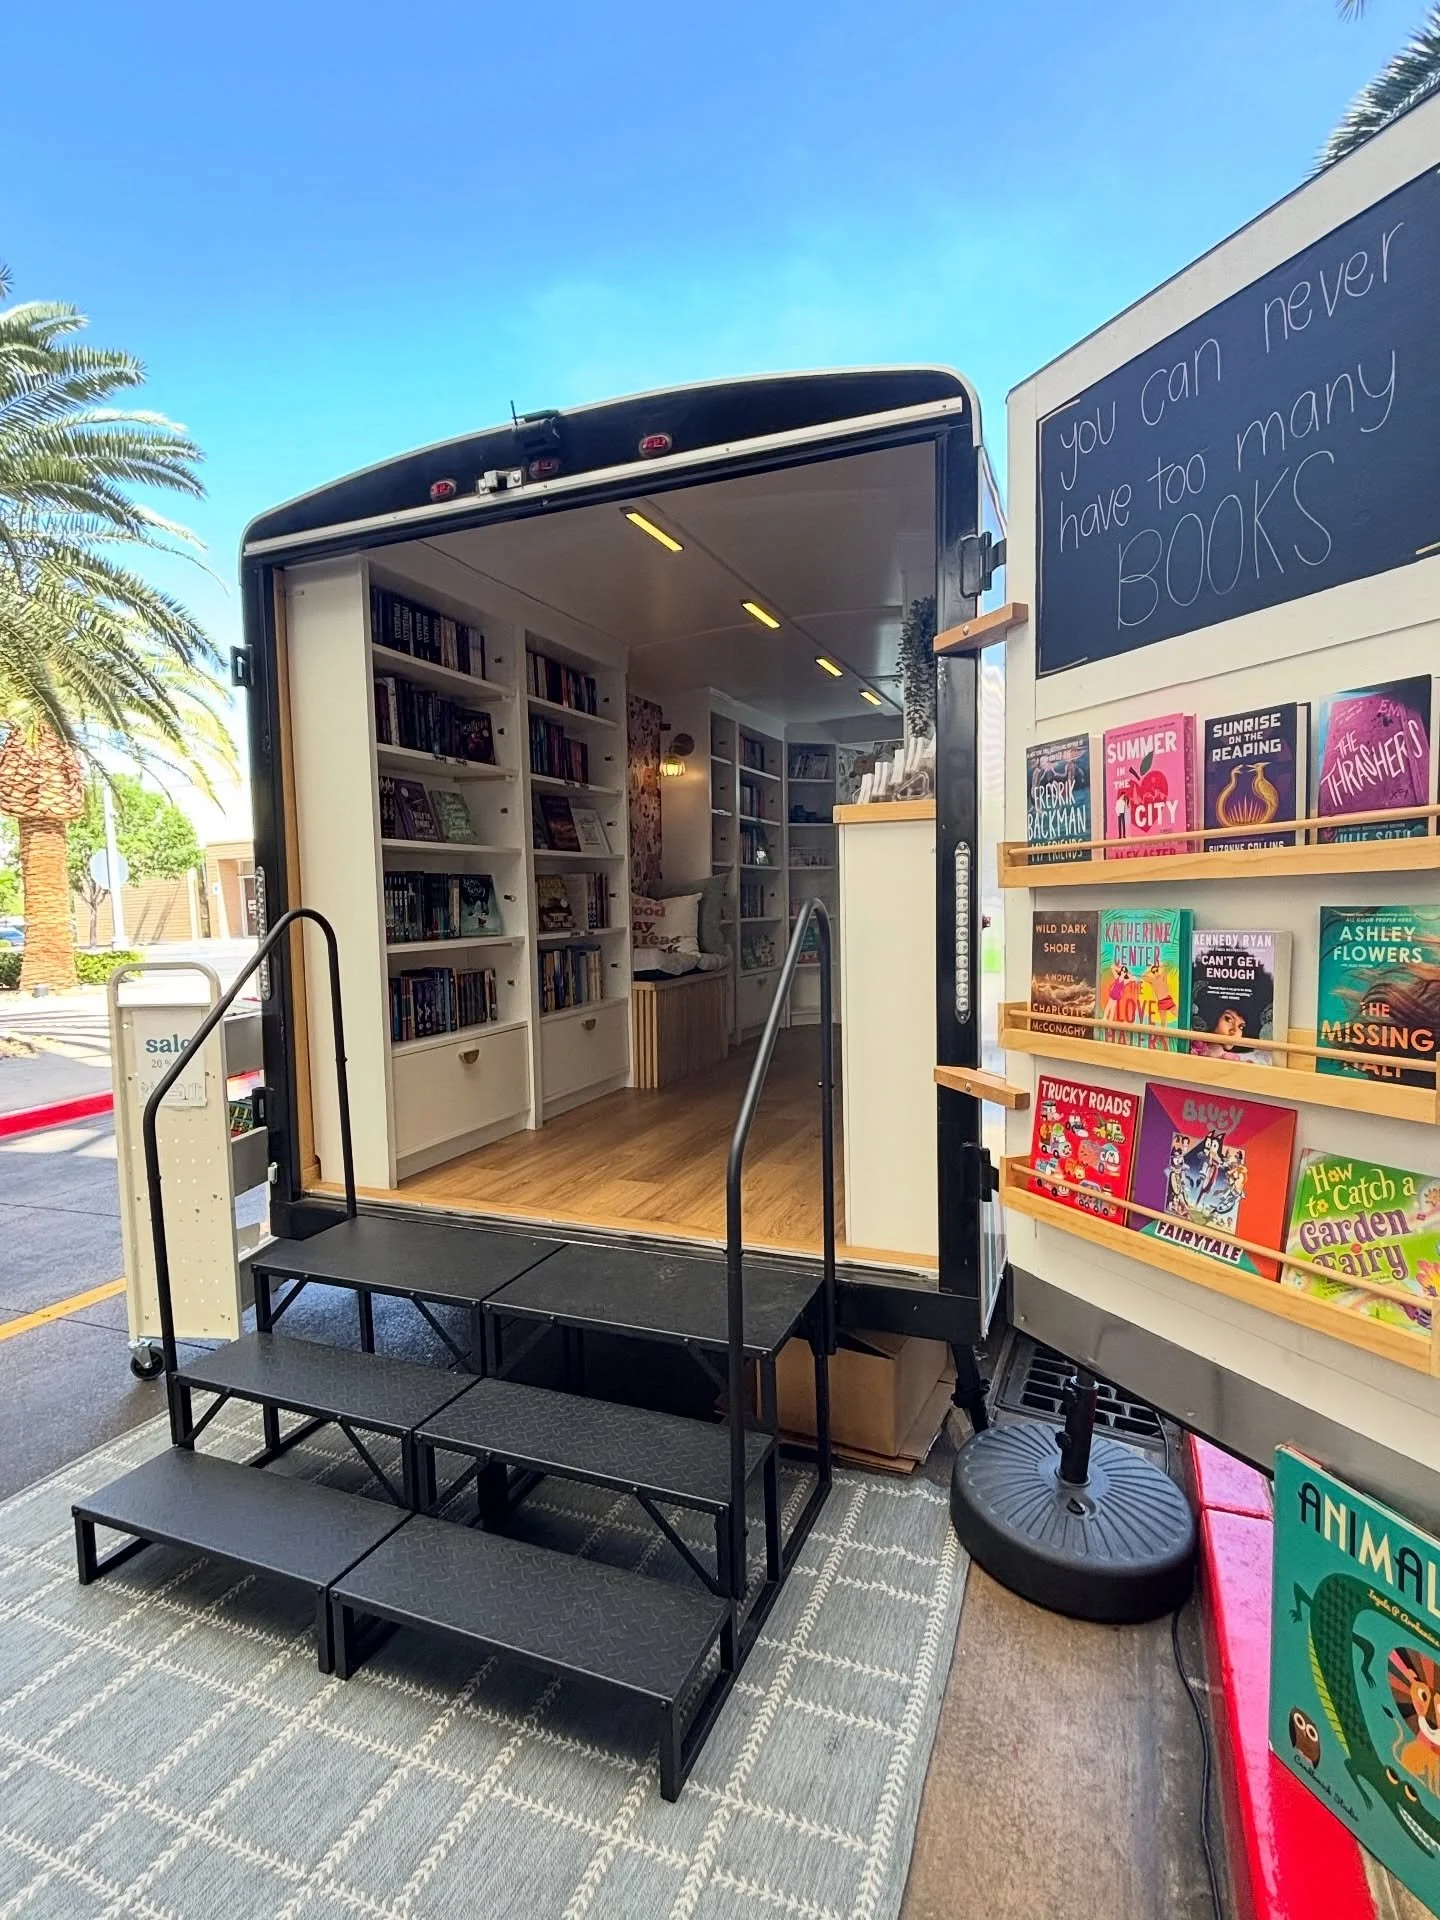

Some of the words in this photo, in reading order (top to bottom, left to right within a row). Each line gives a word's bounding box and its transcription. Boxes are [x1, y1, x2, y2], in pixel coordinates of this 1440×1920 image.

[1060, 401, 1116, 490] you
[1141, 338, 1221, 425] can
[1265, 221, 1404, 353] never
[1059, 483, 1132, 553] have
[1147, 452, 1207, 510] too
[1236, 350, 1396, 472] many
[1117, 450, 1335, 630] BOOKS
[1213, 713, 1281, 738] SUNRISE
[1107, 730, 1178, 764] SUMMER
[1229, 735, 1243, 745] ON
[1244, 731, 1264, 743] THE
[1335, 730, 1359, 759] THE
[1212, 738, 1282, 762] REAPING
[1116, 766, 1126, 777] IN
[1320, 719, 1423, 807] THRASHERS
[1113, 779, 1131, 790] THE
[1034, 779, 1076, 815] FREDRIK
[1027, 804, 1087, 841] BACKMAN
[1134, 799, 1179, 828] CITY
[632, 905, 666, 917] ood
[632, 921, 656, 933] ay
[1036, 924, 1057, 934] WILD
[1061, 924, 1087, 934] DARK
[1105, 922, 1172, 944] KATHERINE
[1340, 926, 1416, 942] ASHLEY
[1043, 942, 1076, 954] SHORE
[1194, 934, 1238, 948] KENNEDY
[1243, 934, 1272, 948] RYAN
[1114, 945, 1160, 967] CENTER
[1201, 955, 1234, 967] CAN'T
[1237, 956, 1260, 968] GET
[1333, 945, 1423, 964] FLOWERS
[1051, 974, 1075, 982] NOVEL
[1206, 967, 1255, 980] ENOUGH
[1128, 980, 1144, 995] THE
[1032, 1003, 1087, 1018] CHARLOTTE
[1116, 999, 1156, 1026] LOVE
[1360, 1001, 1391, 1018] THE
[1031, 1021, 1087, 1037] McCONAGHY
[1321, 1019, 1435, 1052] MISSING
[152, 1059, 162, 1068] 20
[1041, 1080, 1088, 1107] TRUCKY
[1088, 1091, 1132, 1118] ROADS
[1308, 1163, 1353, 1195] How
[1306, 1195, 1329, 1218] to
[1333, 1168, 1396, 1211] Catch
[1402, 1176, 1417, 1197] a
[1157, 1221, 1242, 1262] FAIRYTALE
[1300, 1209, 1413, 1254] Garden
[1312, 1243, 1409, 1283] Fairy
